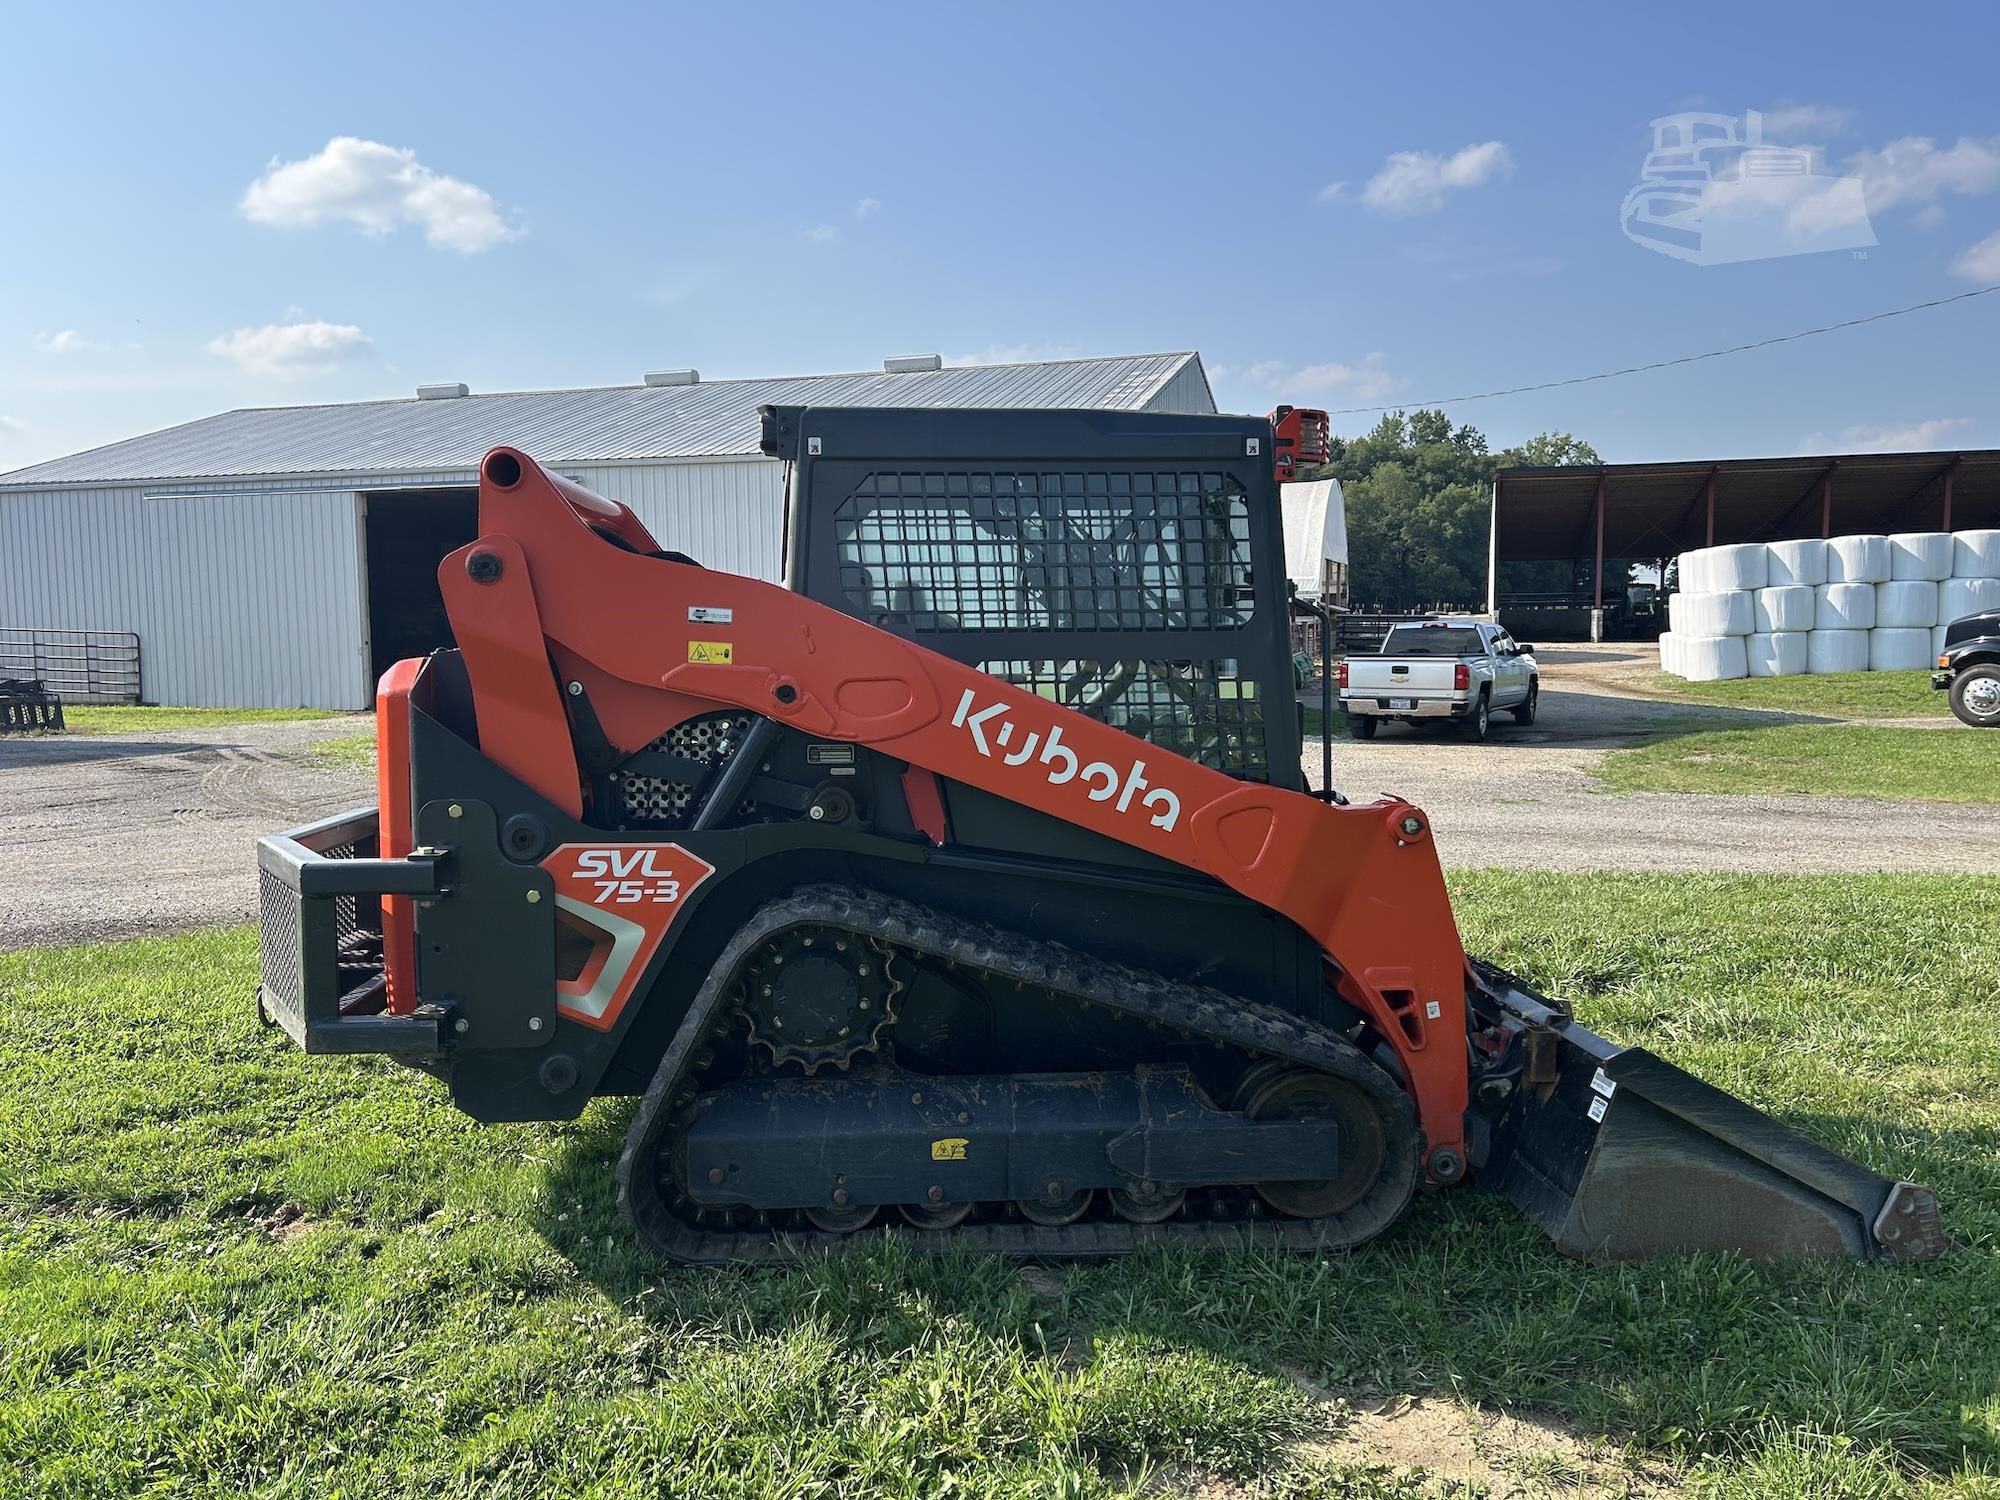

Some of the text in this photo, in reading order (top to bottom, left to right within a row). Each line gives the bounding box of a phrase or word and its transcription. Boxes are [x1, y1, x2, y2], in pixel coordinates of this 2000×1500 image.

[951, 688, 1181, 832] Kubota
[571, 850, 673, 877] SVL
[593, 881, 680, 903] 75-3
